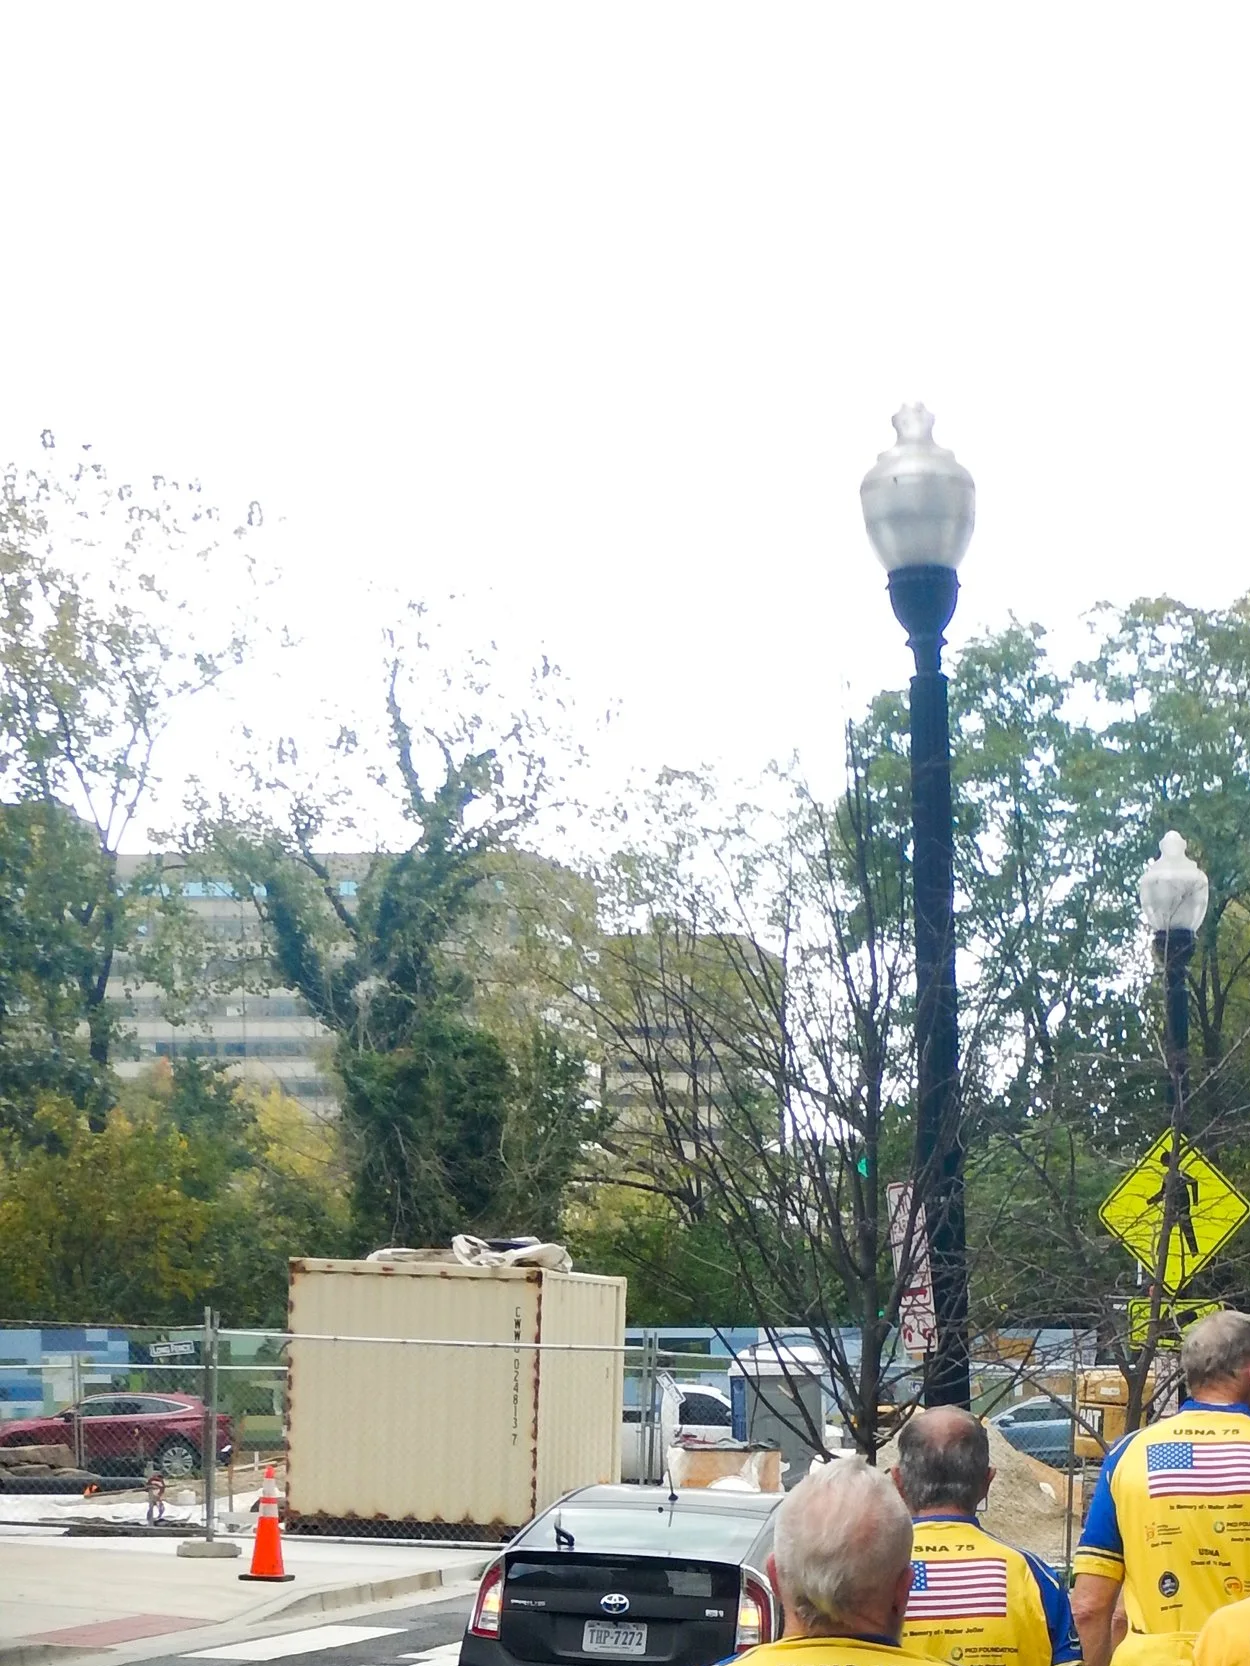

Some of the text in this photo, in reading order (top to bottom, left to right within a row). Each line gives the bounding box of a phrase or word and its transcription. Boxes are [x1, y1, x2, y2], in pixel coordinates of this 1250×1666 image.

[955, 1544, 975, 1552] 75
[1198, 1548, 1220, 1556] USNA
[589, 1629, 643, 1646] THP-7272
